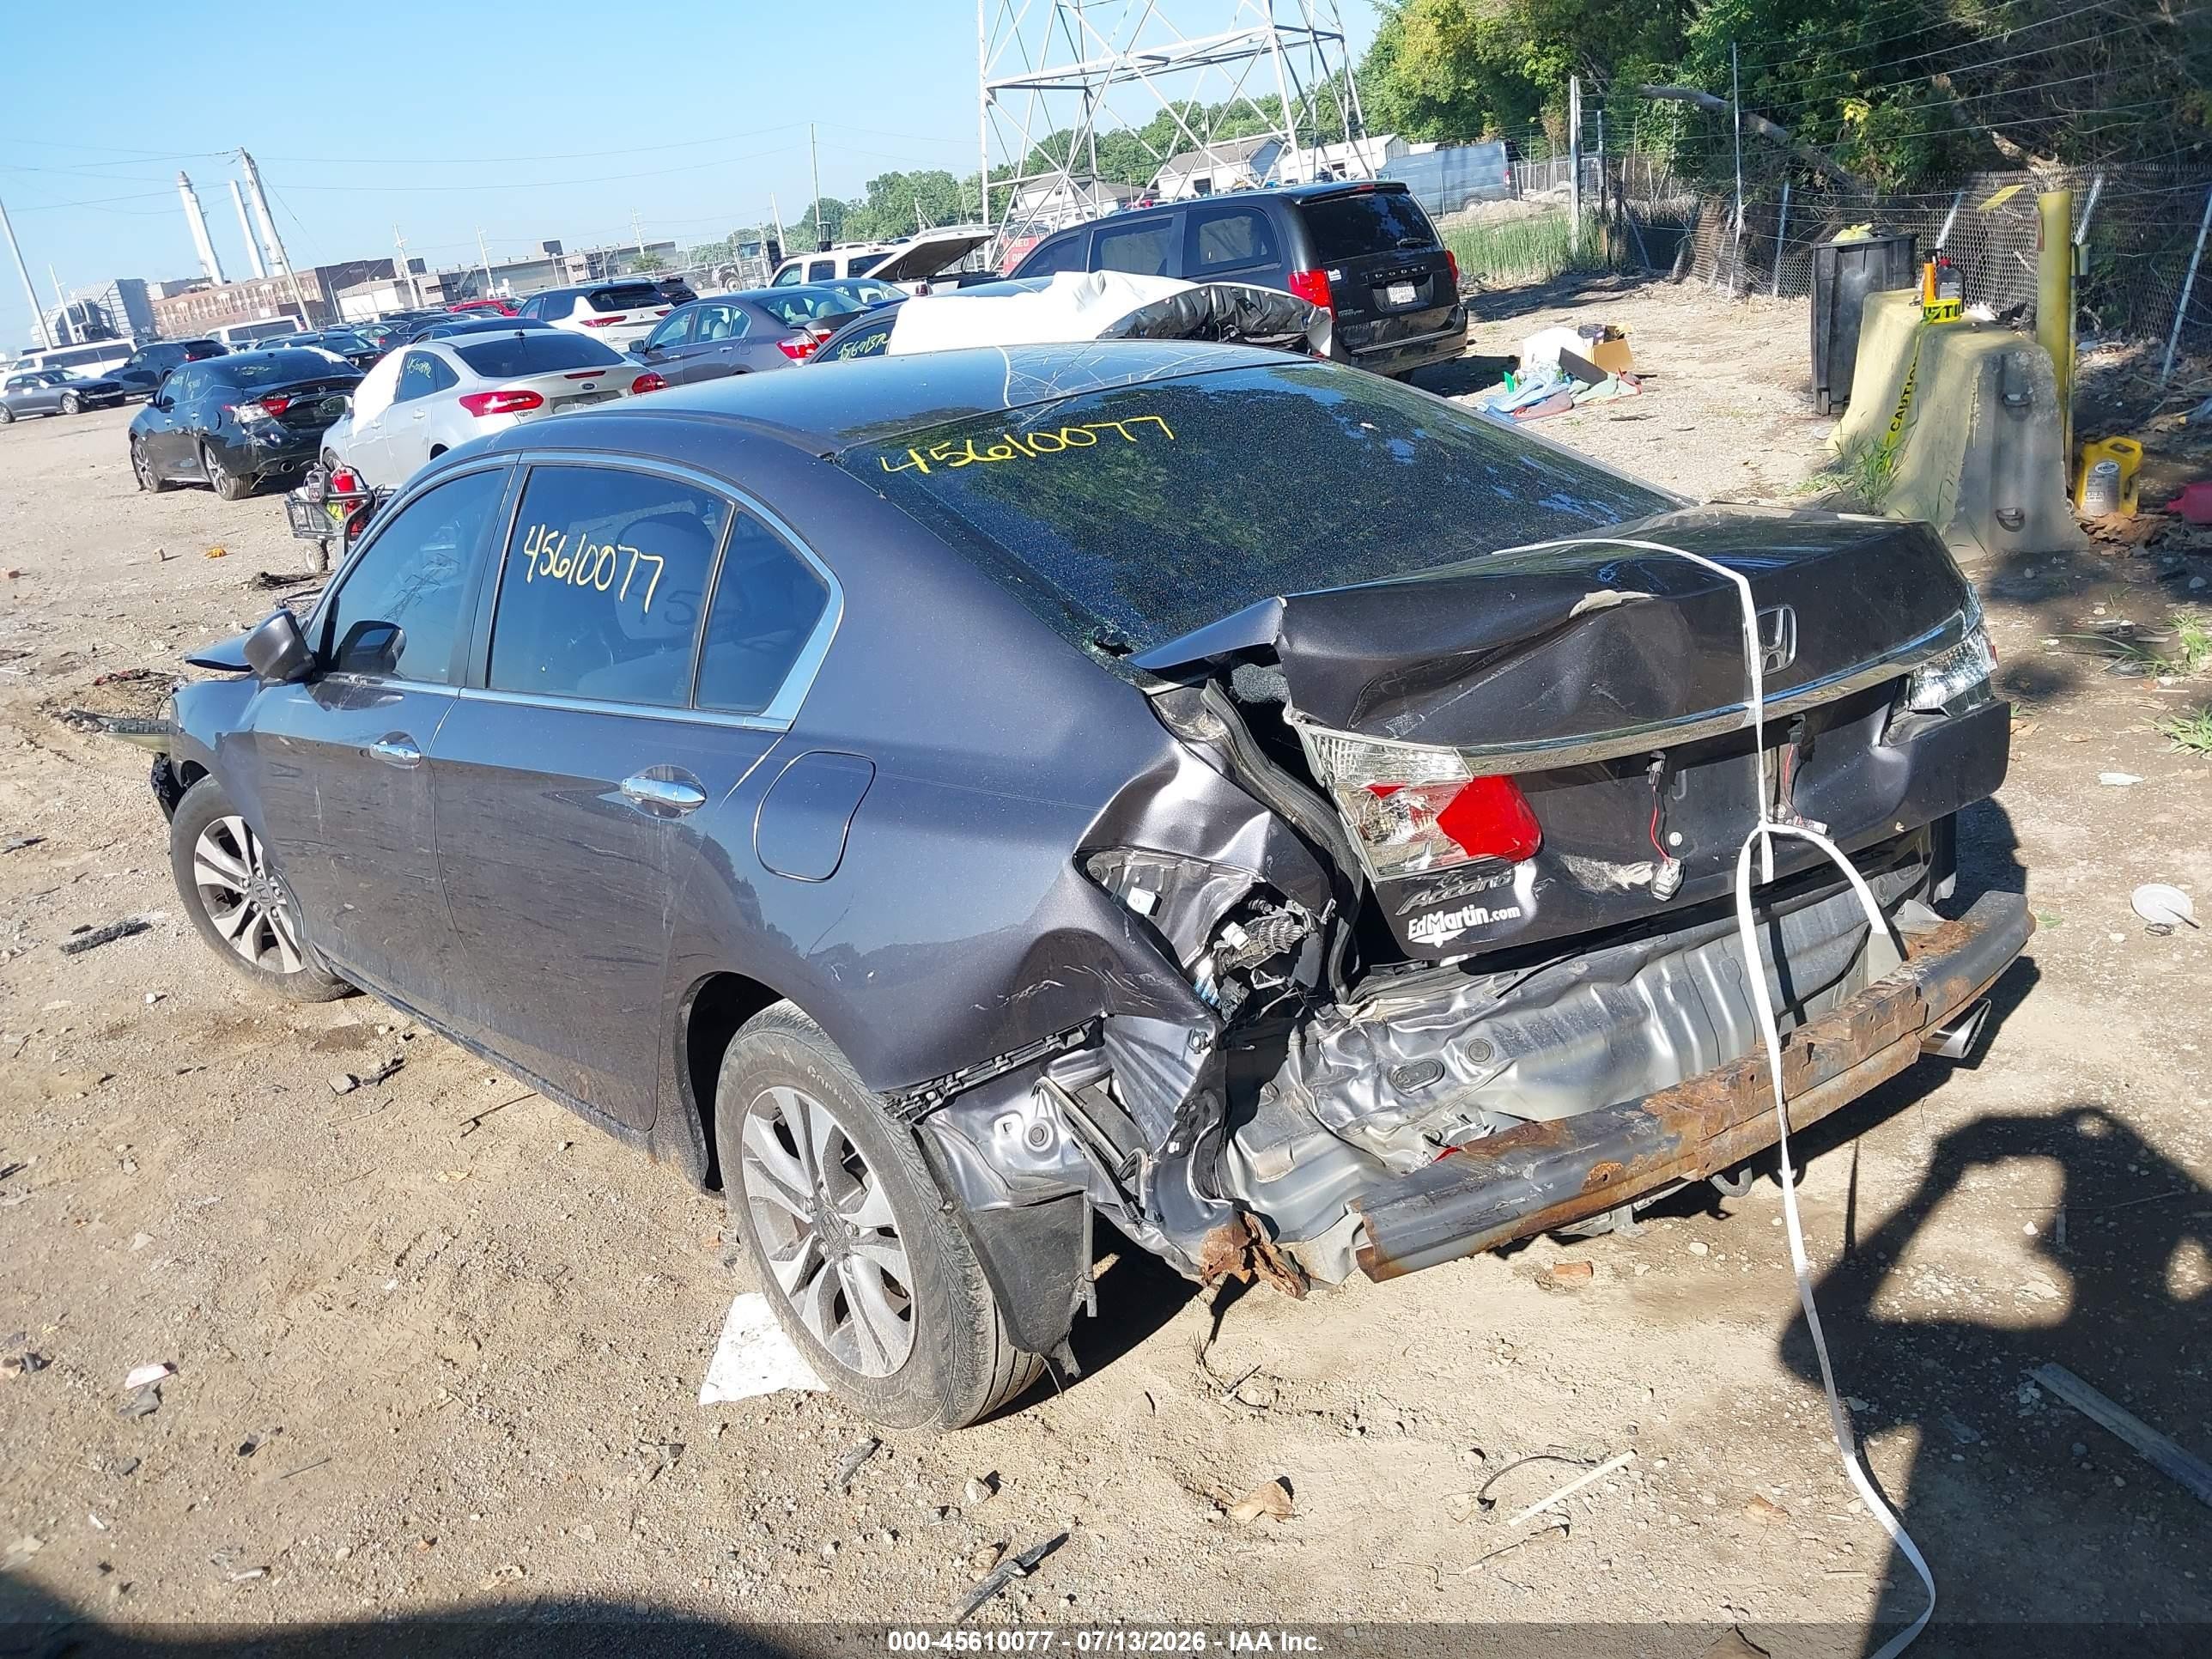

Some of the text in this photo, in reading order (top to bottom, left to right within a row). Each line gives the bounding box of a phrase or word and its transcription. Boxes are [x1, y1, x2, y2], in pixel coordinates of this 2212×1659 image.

[880, 416, 1174, 473] 45610077
[524, 524, 664, 613] 45610077
[1408, 904, 1522, 940] EdMartin.com
